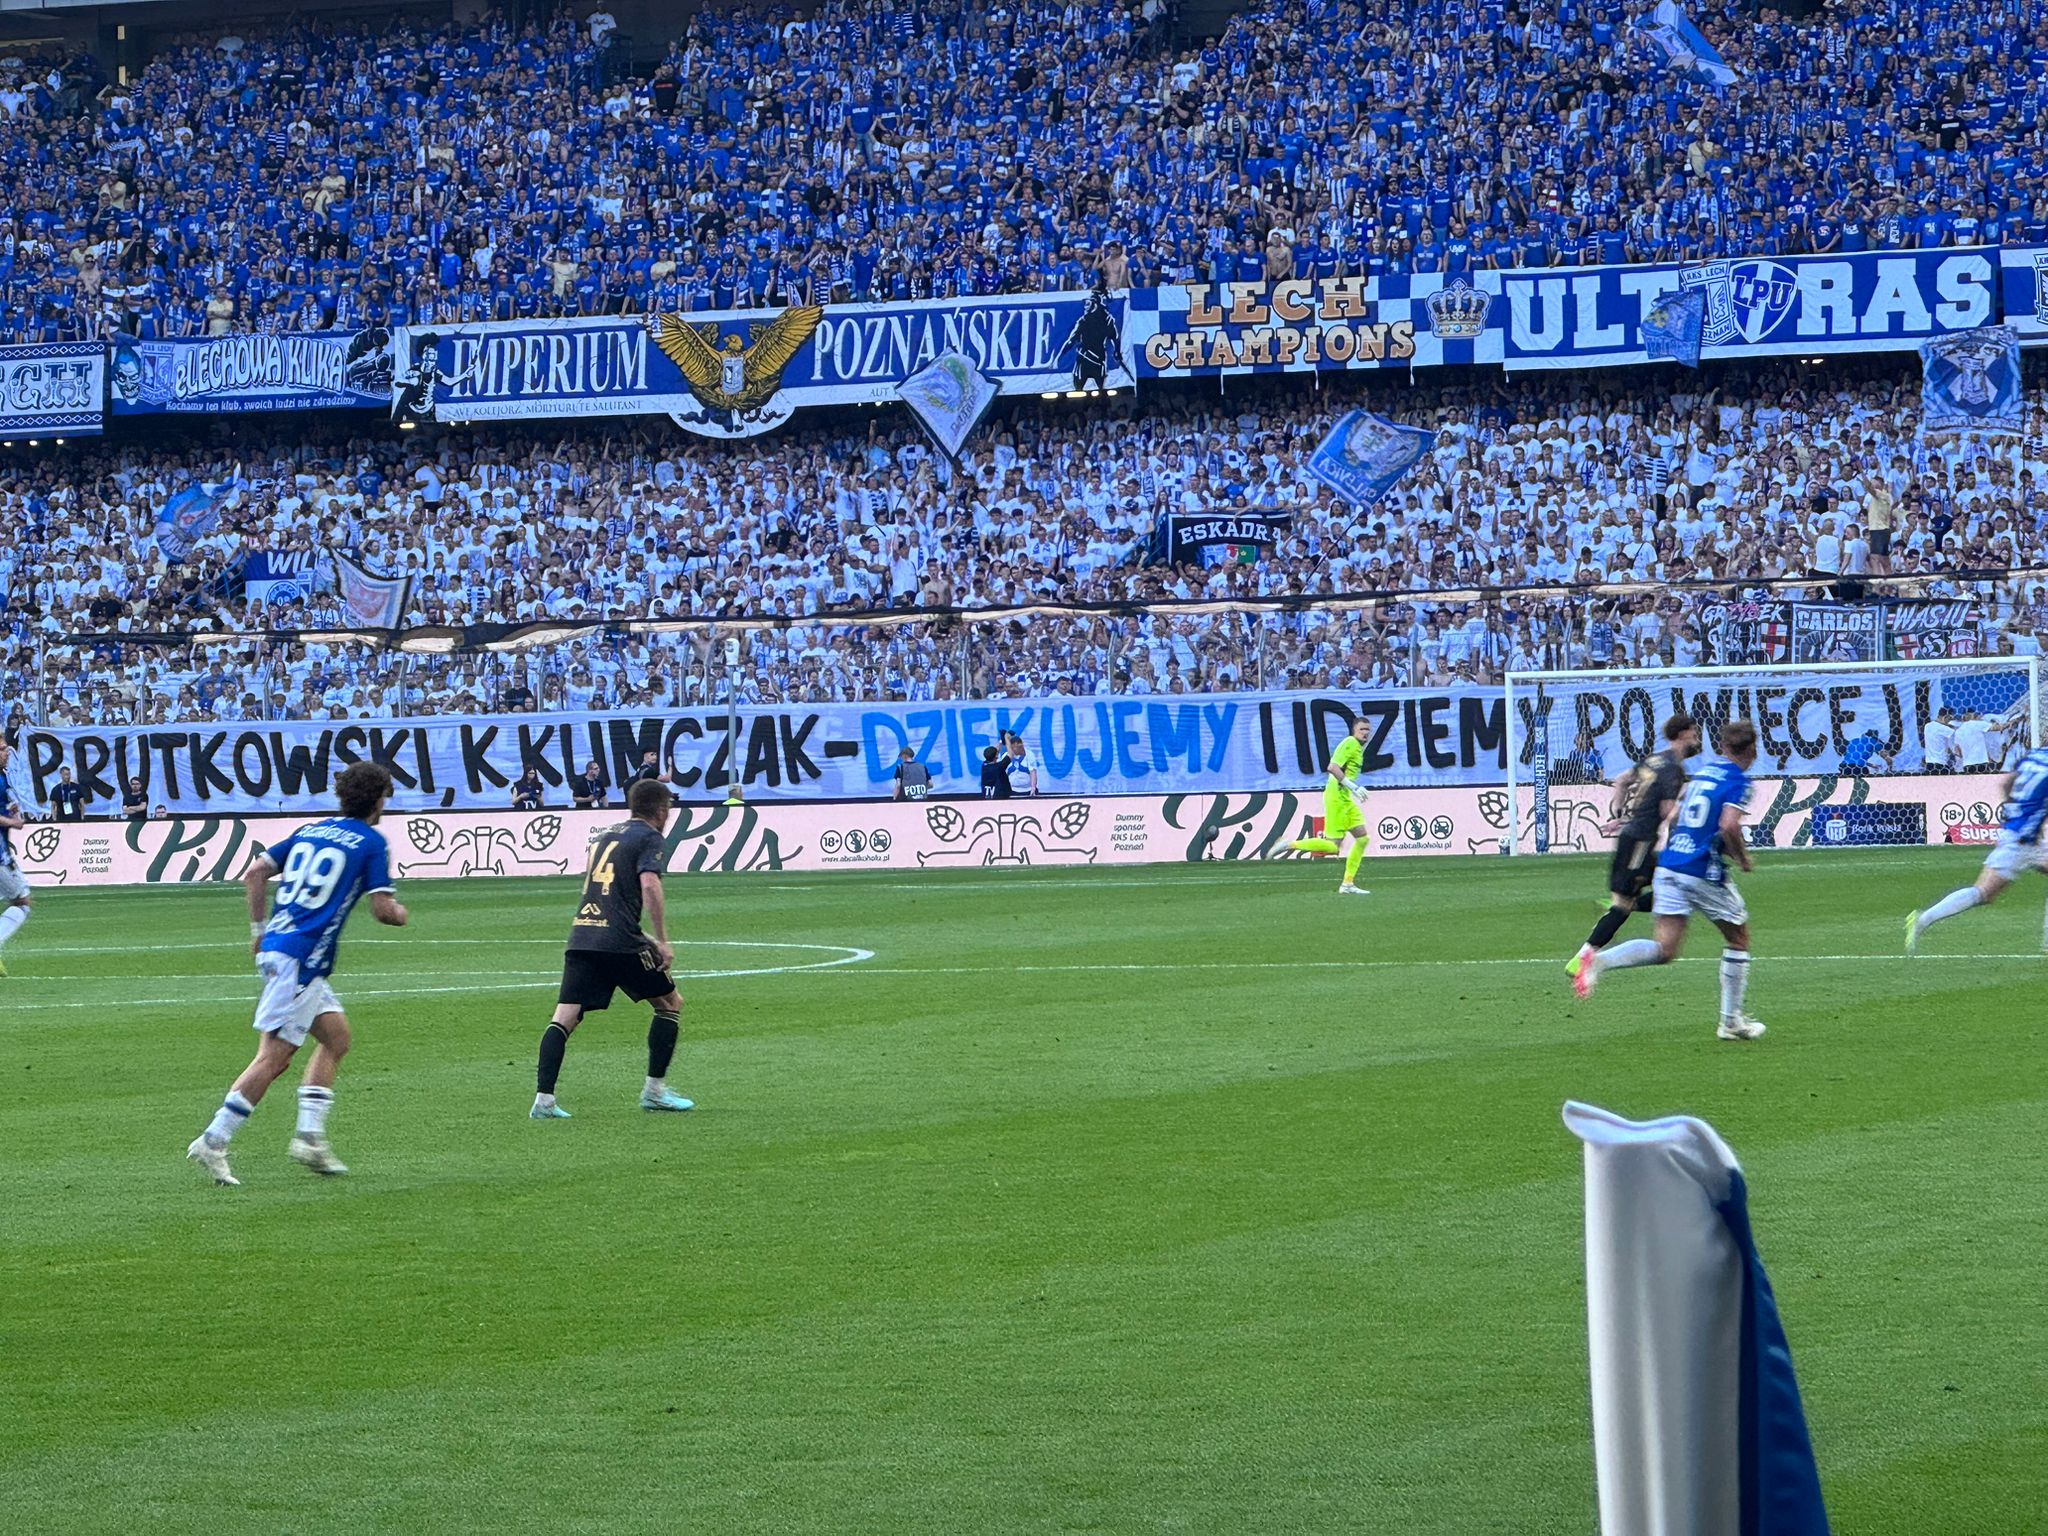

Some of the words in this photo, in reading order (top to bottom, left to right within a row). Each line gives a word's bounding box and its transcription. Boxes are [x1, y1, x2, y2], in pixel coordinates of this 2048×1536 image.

[1185, 276, 1366, 325] LECH
[1733, 274, 1794, 312] LPU
[1796, 254, 1992, 336] RAS
[449, 330, 649, 398] IMPERIUM
[810, 307, 1057, 381] POZNAŃSKIE
[1144, 320, 1415, 369] CHAMPIONS
[286, 336, 347, 395] KLIKA
[297, 398, 311, 408] nie
[1178, 521, 1282, 545] ESKADRA
[267, 550, 317, 575] WIL
[1799, 610, 1873, 632] CARLOS
[1574, 687, 1655, 764] PO
[1535, 754, 1546, 777] LECH
[904, 784, 926, 796] FOTO
[984, 785, 996, 796] TV
[523, 800, 537, 809] TV
[1381, 823, 1399, 834] 18+
[1959, 827, 2001, 842] SUPE
[823, 836, 840, 848] 18+
[275, 841, 347, 910] 99
[582, 840, 620, 896] 14
